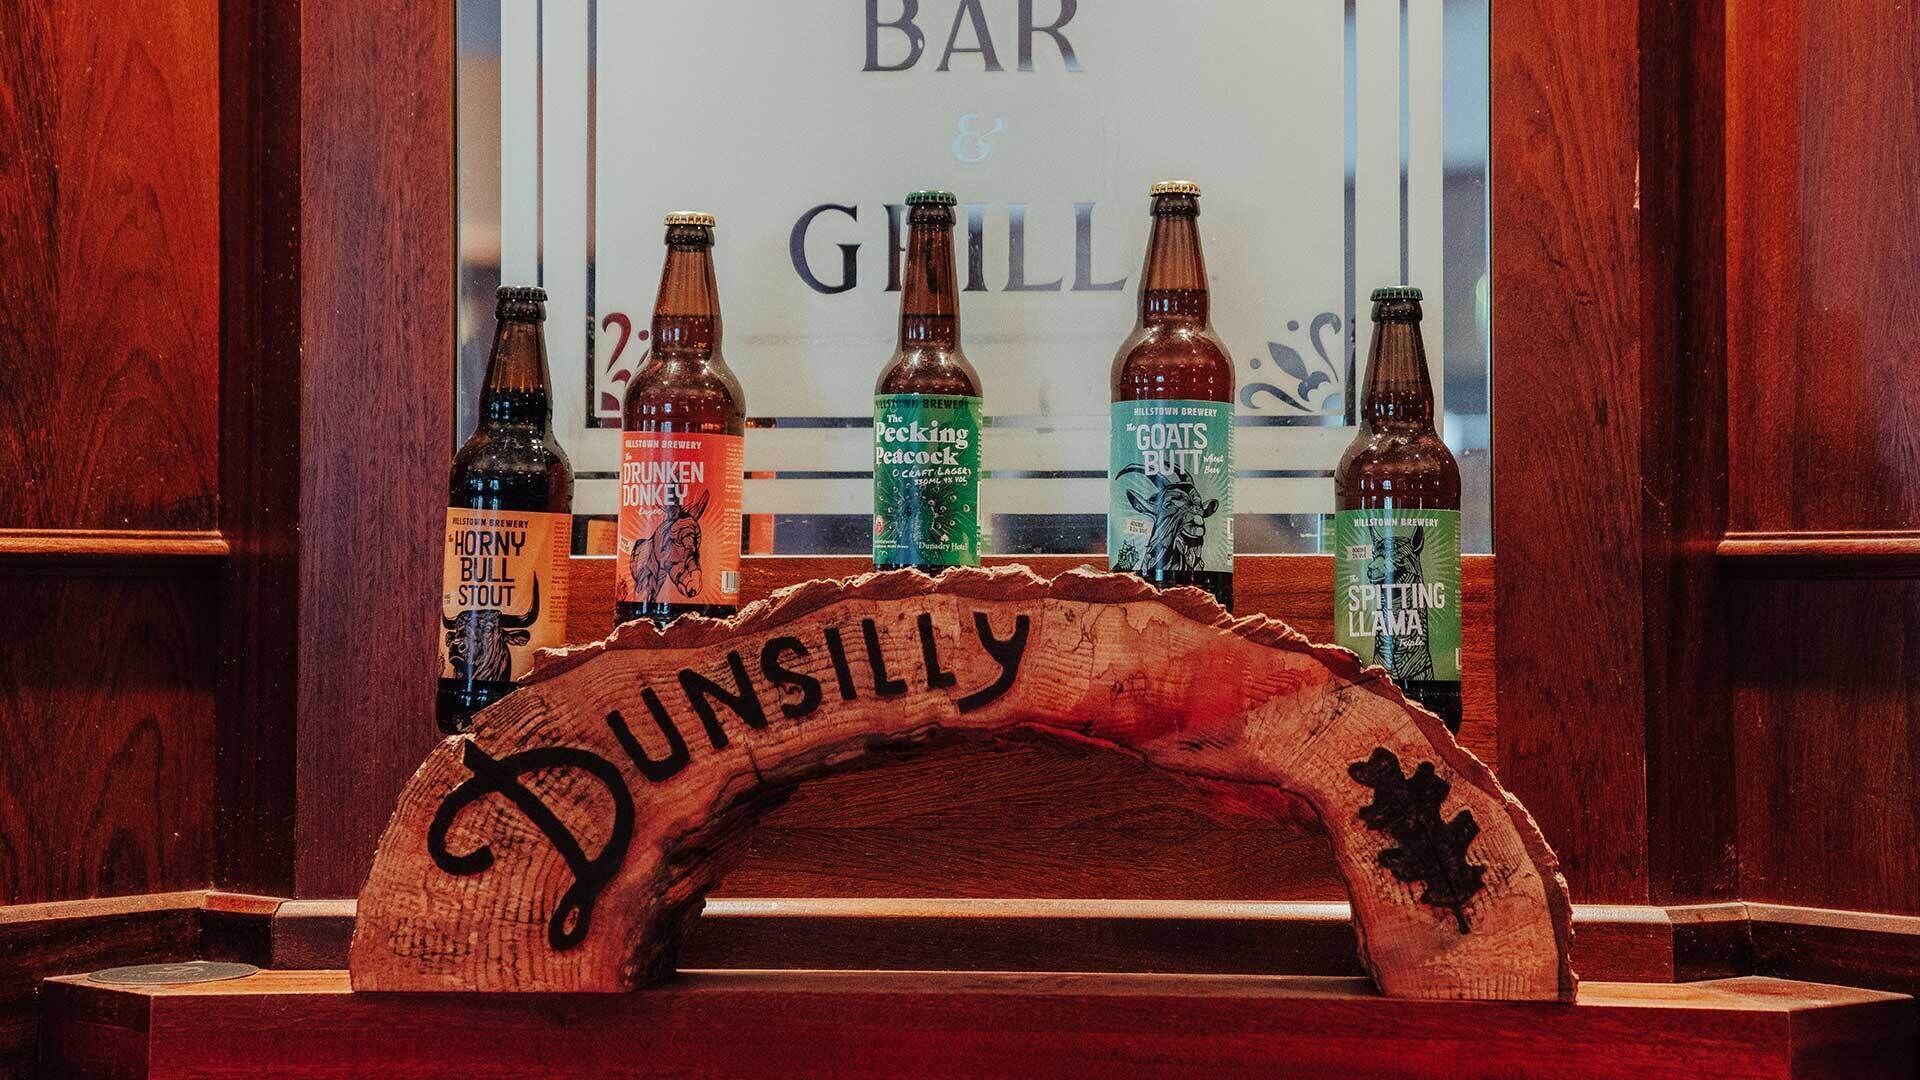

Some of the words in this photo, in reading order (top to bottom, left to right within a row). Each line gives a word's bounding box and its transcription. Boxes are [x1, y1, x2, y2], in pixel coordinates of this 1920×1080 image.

[861, 0, 1085, 72] BAR
[952, 113, 1007, 164] &
[887, 414, 903, 423] The
[1134, 407, 1178, 416] HILLSTOWN
[1181, 408, 1217, 417] BREWERY
[661, 441, 702, 449] BREWERY
[876, 420, 969, 449] Pecking
[1136, 422, 1208, 450] GOATS
[876, 447, 959, 465] Peacock
[1143, 449, 1202, 475] BUTT
[623, 461, 704, 484] DRUNKEN
[901, 468, 934, 478] CRAFT
[937, 467, 968, 476] LAGER
[623, 484, 688, 507] DONKEY
[489, 519, 529, 528] BREWERY
[1354, 518, 1397, 527] HILLSTOWN
[1400, 518, 1438, 527] BREWERY
[455, 530, 526, 556] HORNY
[919, 542, 949, 551] Dunadry
[951, 543, 967, 551] Hotel
[460, 557, 515, 582] BULL
[458, 585, 515, 606] STOUT
[1348, 582, 1445, 611] SPITTING
[1348, 609, 1423, 637] LLAMA
[427, 612, 1029, 950] DUNSILLY
